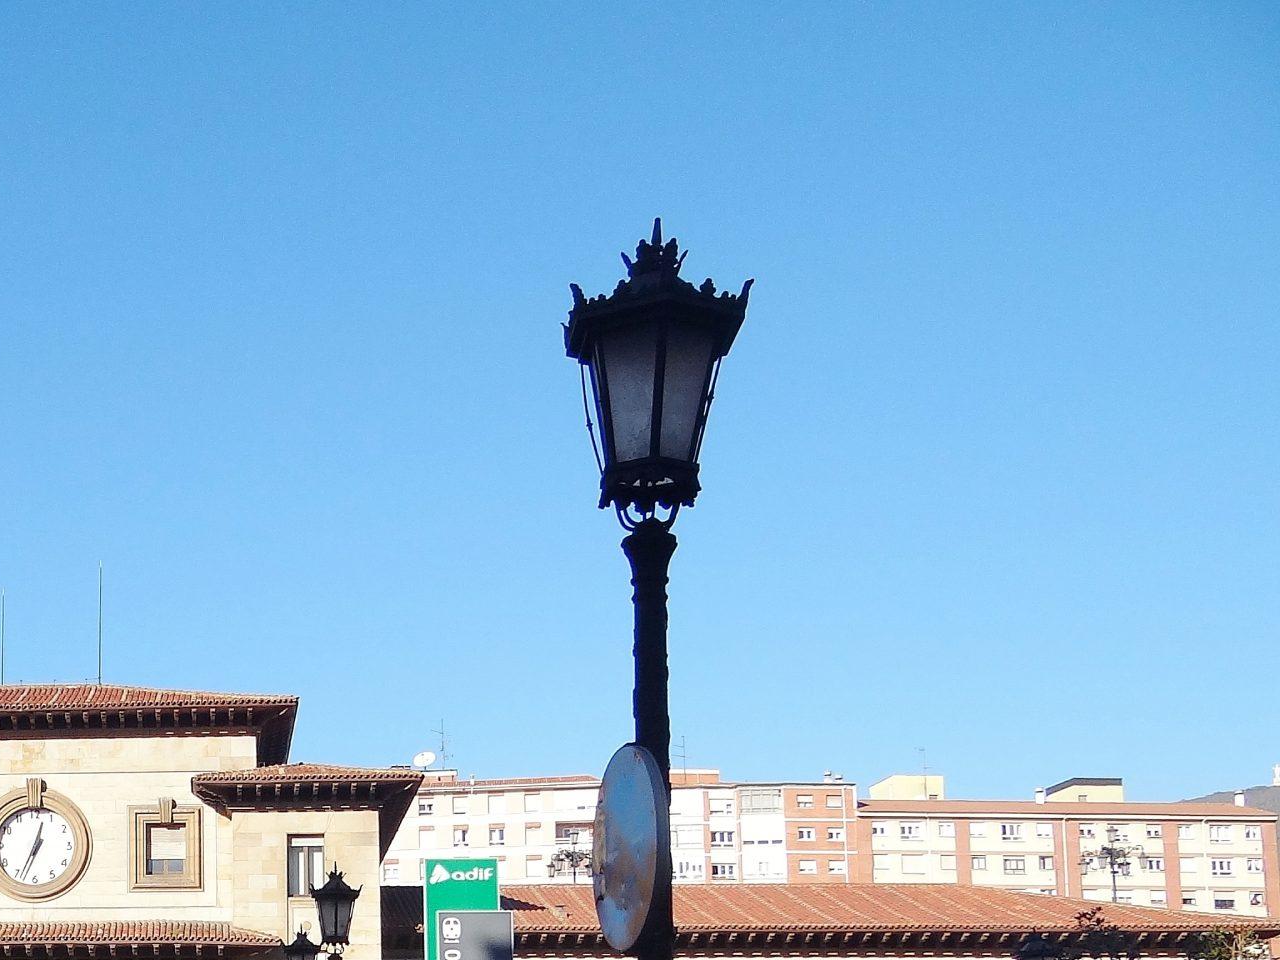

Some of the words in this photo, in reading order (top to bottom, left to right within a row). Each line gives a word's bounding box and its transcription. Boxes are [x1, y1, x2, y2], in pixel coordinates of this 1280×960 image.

[16, 814, 22, 823] 11
[30, 810, 40, 819] 12
[61, 824, 67, 833] 2
[66, 841, 72, 850] 3
[2, 858, 8, 867] 8
[61, 859, 67, 867] 4
[49, 870, 56, 879] 5
[451, 867, 494, 881] adif
[32, 875, 38, 884] 6
